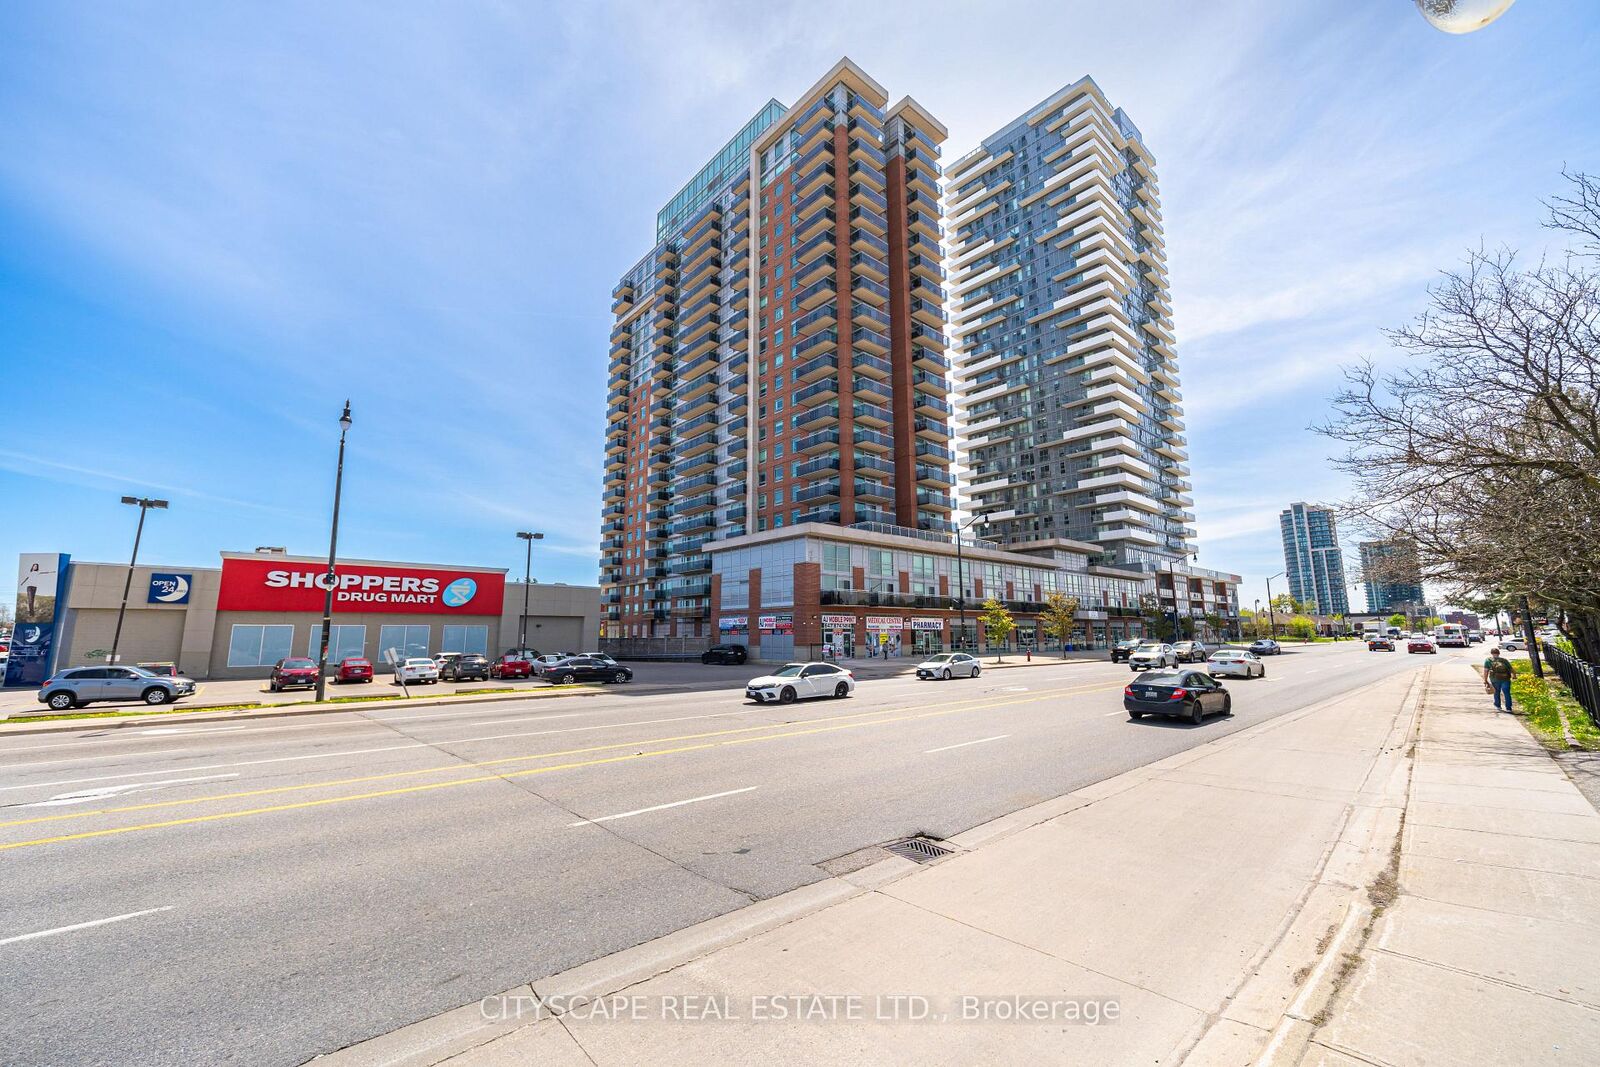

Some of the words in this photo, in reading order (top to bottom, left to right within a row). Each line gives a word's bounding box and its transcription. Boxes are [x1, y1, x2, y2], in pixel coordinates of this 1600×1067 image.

[265, 570, 440, 593] SHOPPERS
[337, 591, 387, 603] DRUG
[391, 593, 437, 604] MART
[912, 621, 942, 629] PHARMACY
